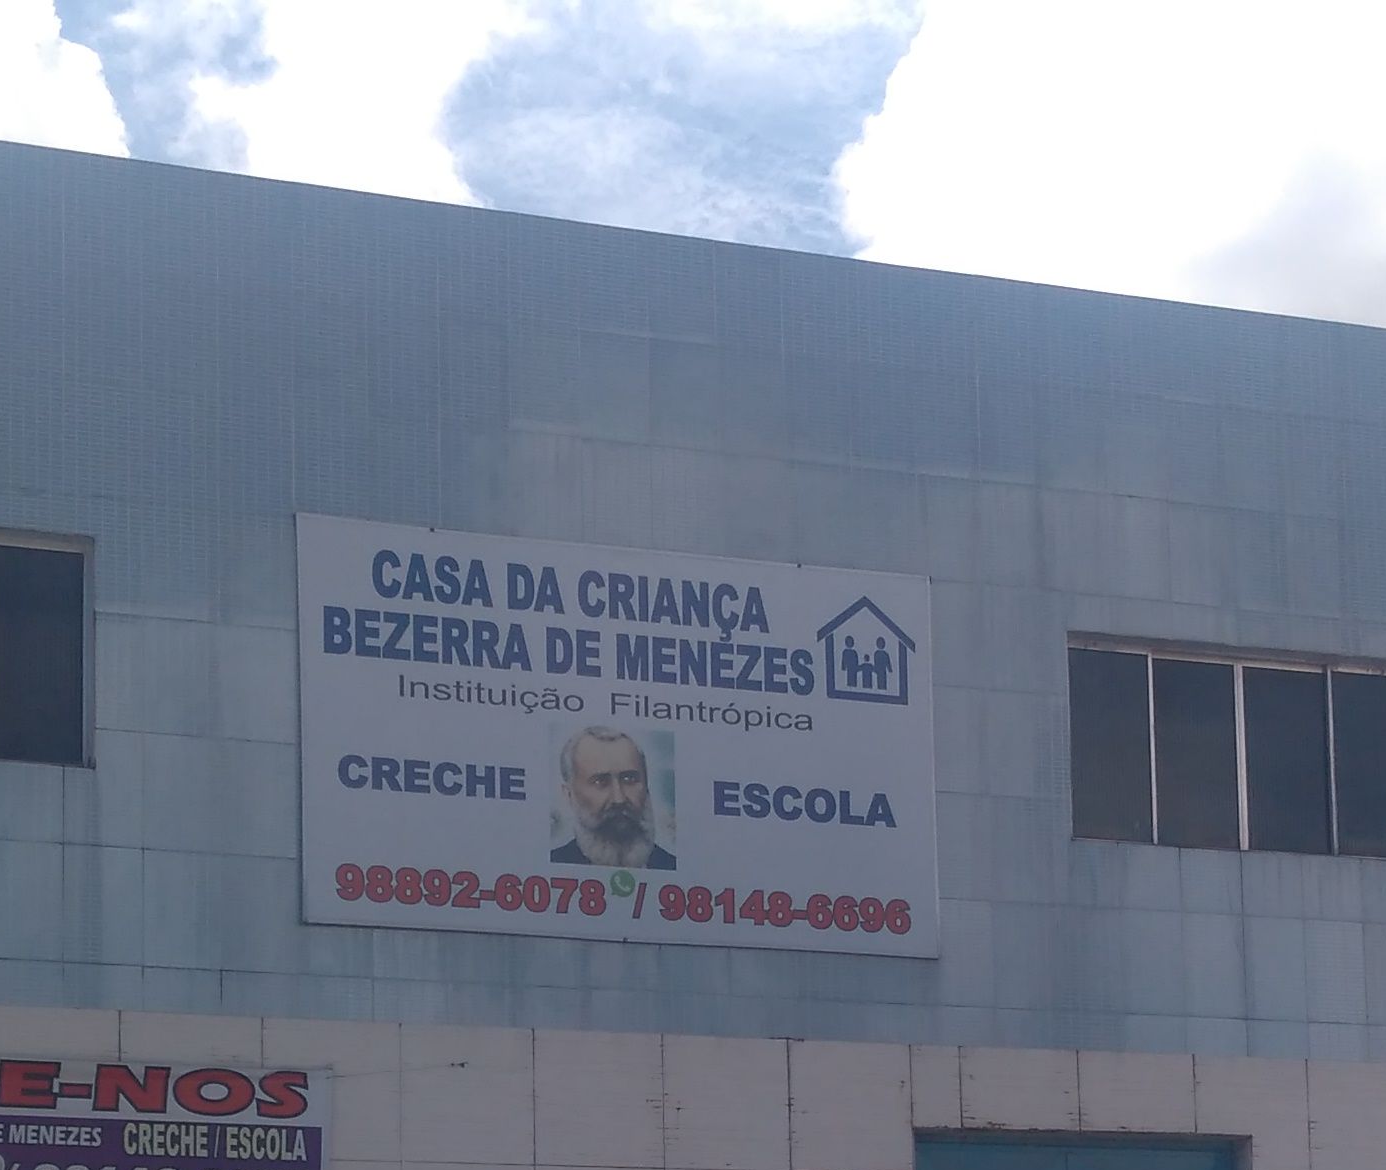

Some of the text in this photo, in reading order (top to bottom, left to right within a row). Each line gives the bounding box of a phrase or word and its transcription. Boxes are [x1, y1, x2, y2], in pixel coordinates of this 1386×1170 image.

[372, 549, 770, 642] CASA DA CRIANÇA
[323, 605, 815, 696] BEZERRA DE MENEZES
[398, 675, 813, 731] Instituição Filantrópica
[337, 755, 897, 828] CRECHE ESCOLA
[334, 862, 607, 917] 98892-6078
[658, 883, 913, 935] 98148-6696
[8, 1124, 102, 1147] MENEZES
[123, 1122, 208, 1158] CRECHE
[226, 1126, 307, 1162] ESCOLA
